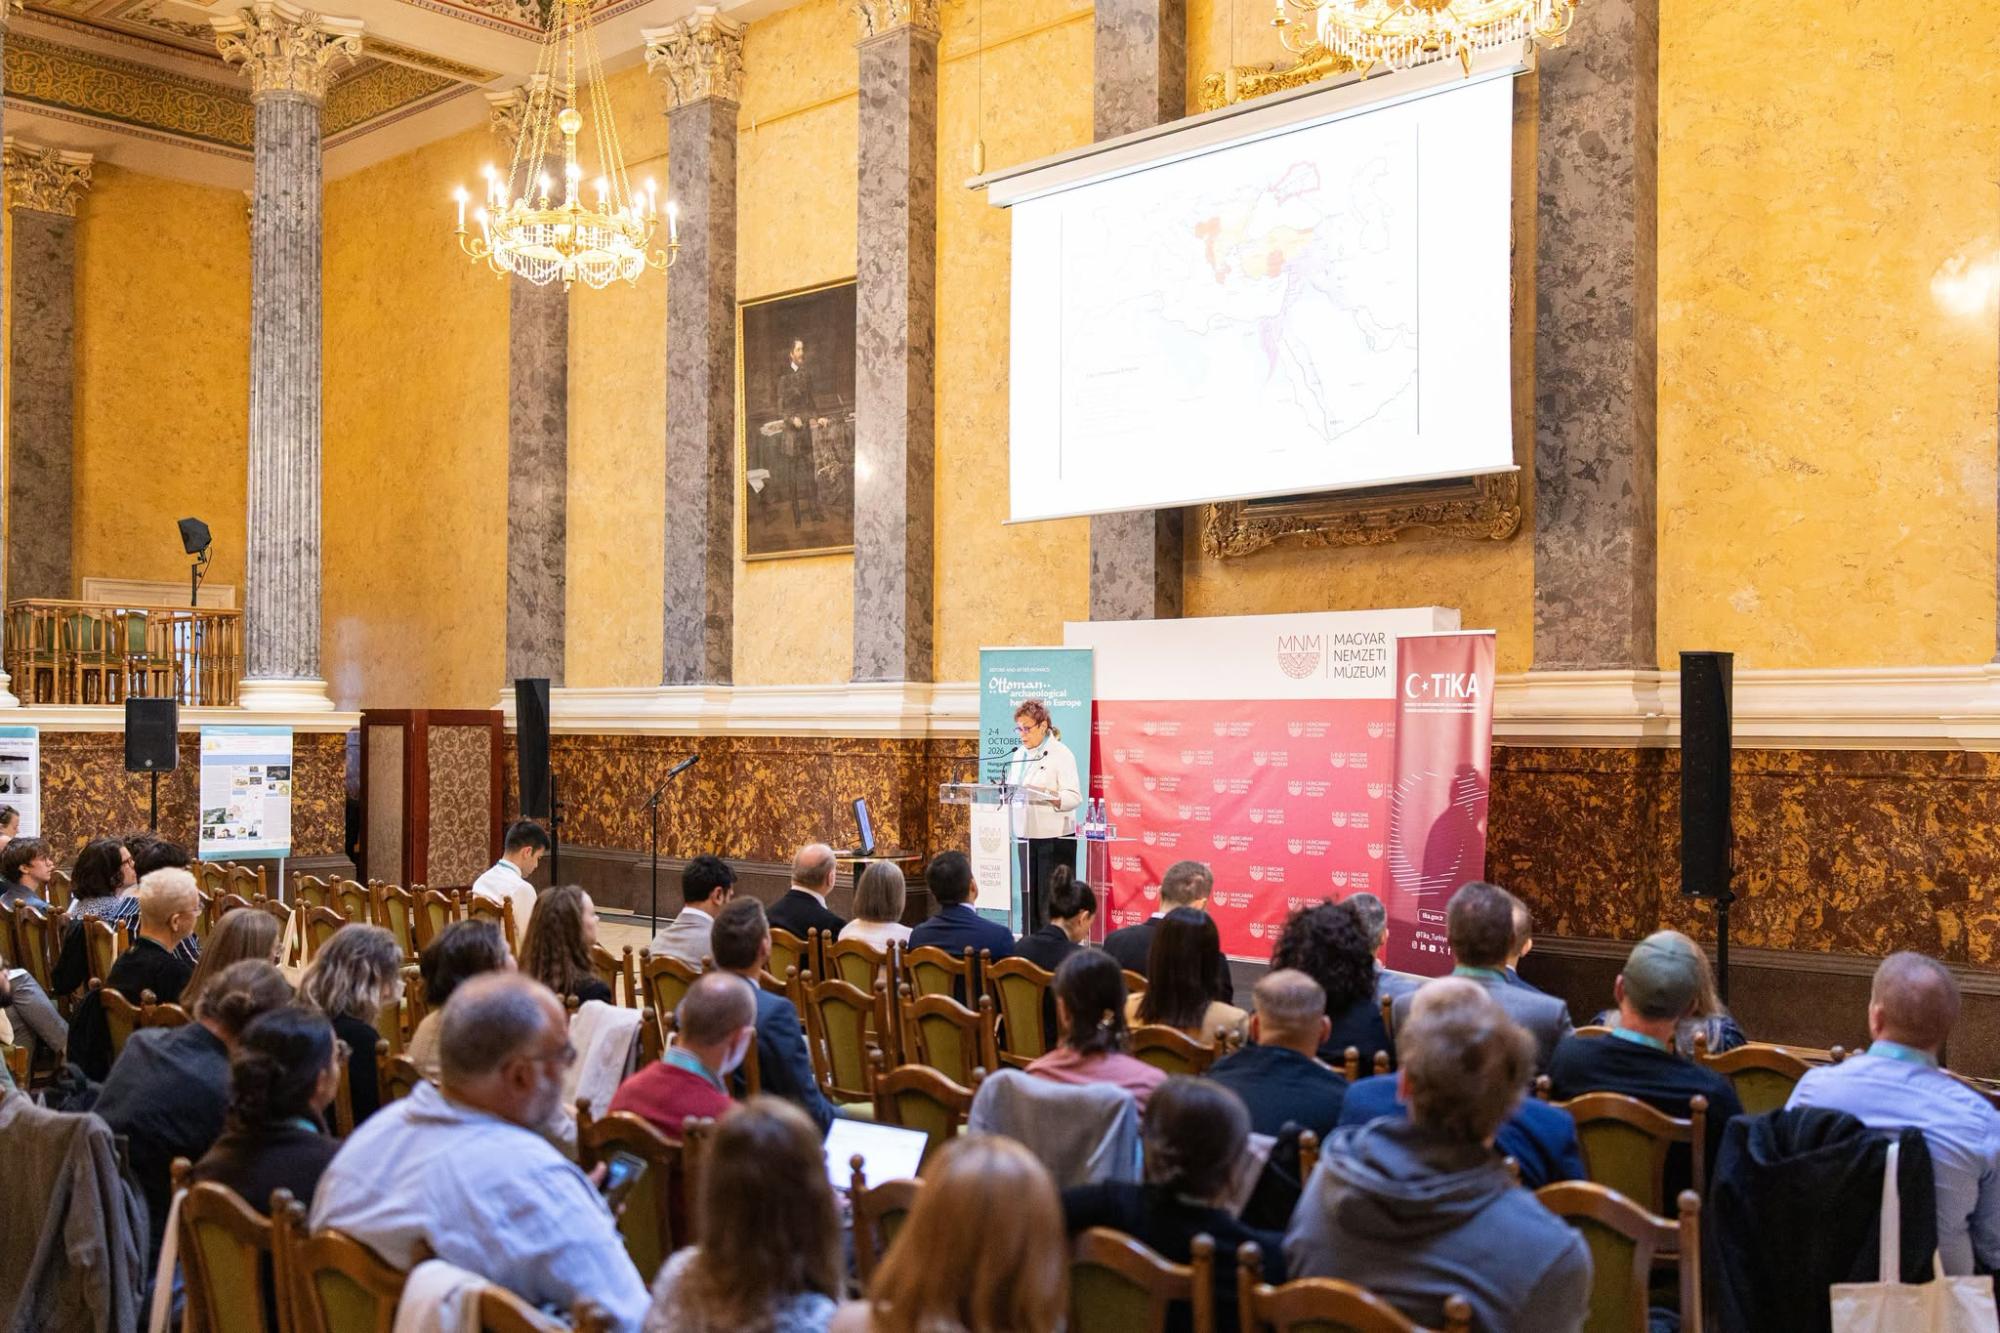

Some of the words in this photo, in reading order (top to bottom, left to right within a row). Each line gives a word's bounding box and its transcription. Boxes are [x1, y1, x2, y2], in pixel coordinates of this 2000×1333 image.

[1278, 634, 1321, 652] MNM
[1334, 632, 1386, 646] MAGYAR
[1334, 648, 1387, 662] NEMZETI
[1334, 664, 1386, 679] MÚZEUM
[1010, 689, 1067, 699] archaeological
[1053, 699, 1082, 709] Europe
[988, 747, 1004, 755] 2026
